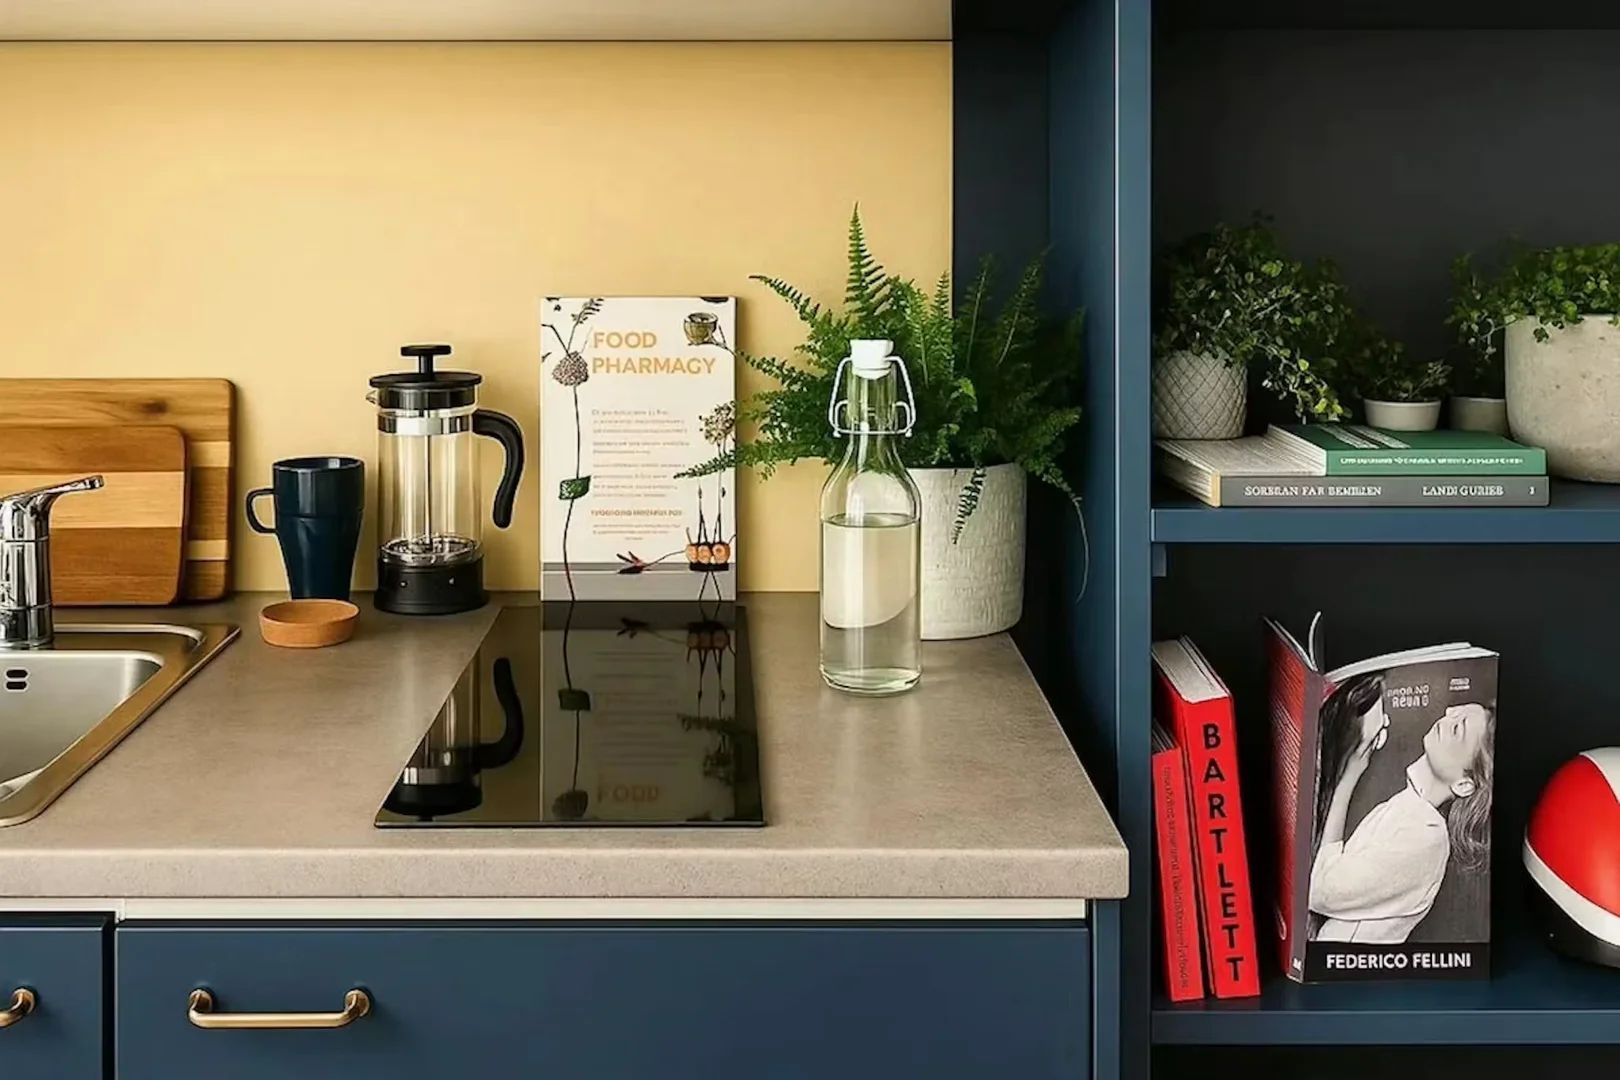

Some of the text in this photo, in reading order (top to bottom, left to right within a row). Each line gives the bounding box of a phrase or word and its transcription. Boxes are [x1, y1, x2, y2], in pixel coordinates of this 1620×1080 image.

[593, 332, 657, 349] FOOD
[1202, 724, 1244, 983] BARTLETT
[1326, 952, 1472, 969] FEDERICO FELLINI
